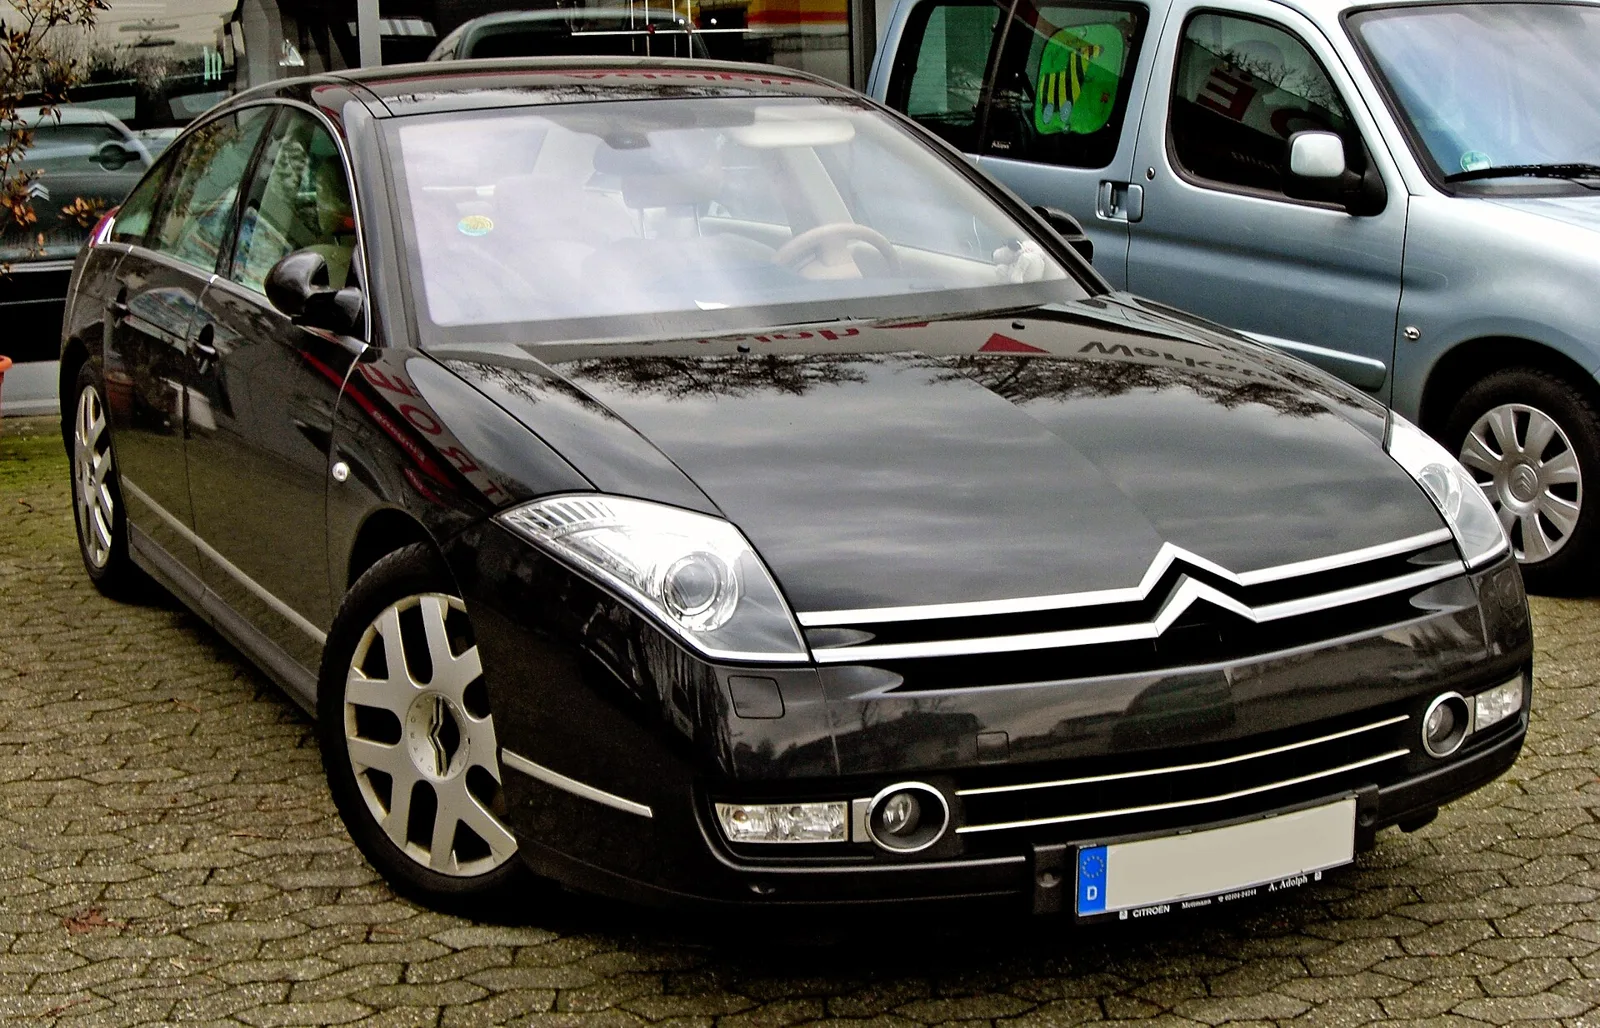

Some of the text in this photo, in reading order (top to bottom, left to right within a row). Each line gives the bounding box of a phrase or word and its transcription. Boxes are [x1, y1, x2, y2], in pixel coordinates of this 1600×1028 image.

[1267, 881, 1278, 892] A.
[1279, 873, 1308, 887] Adolph
[1086, 885, 1098, 901] D
